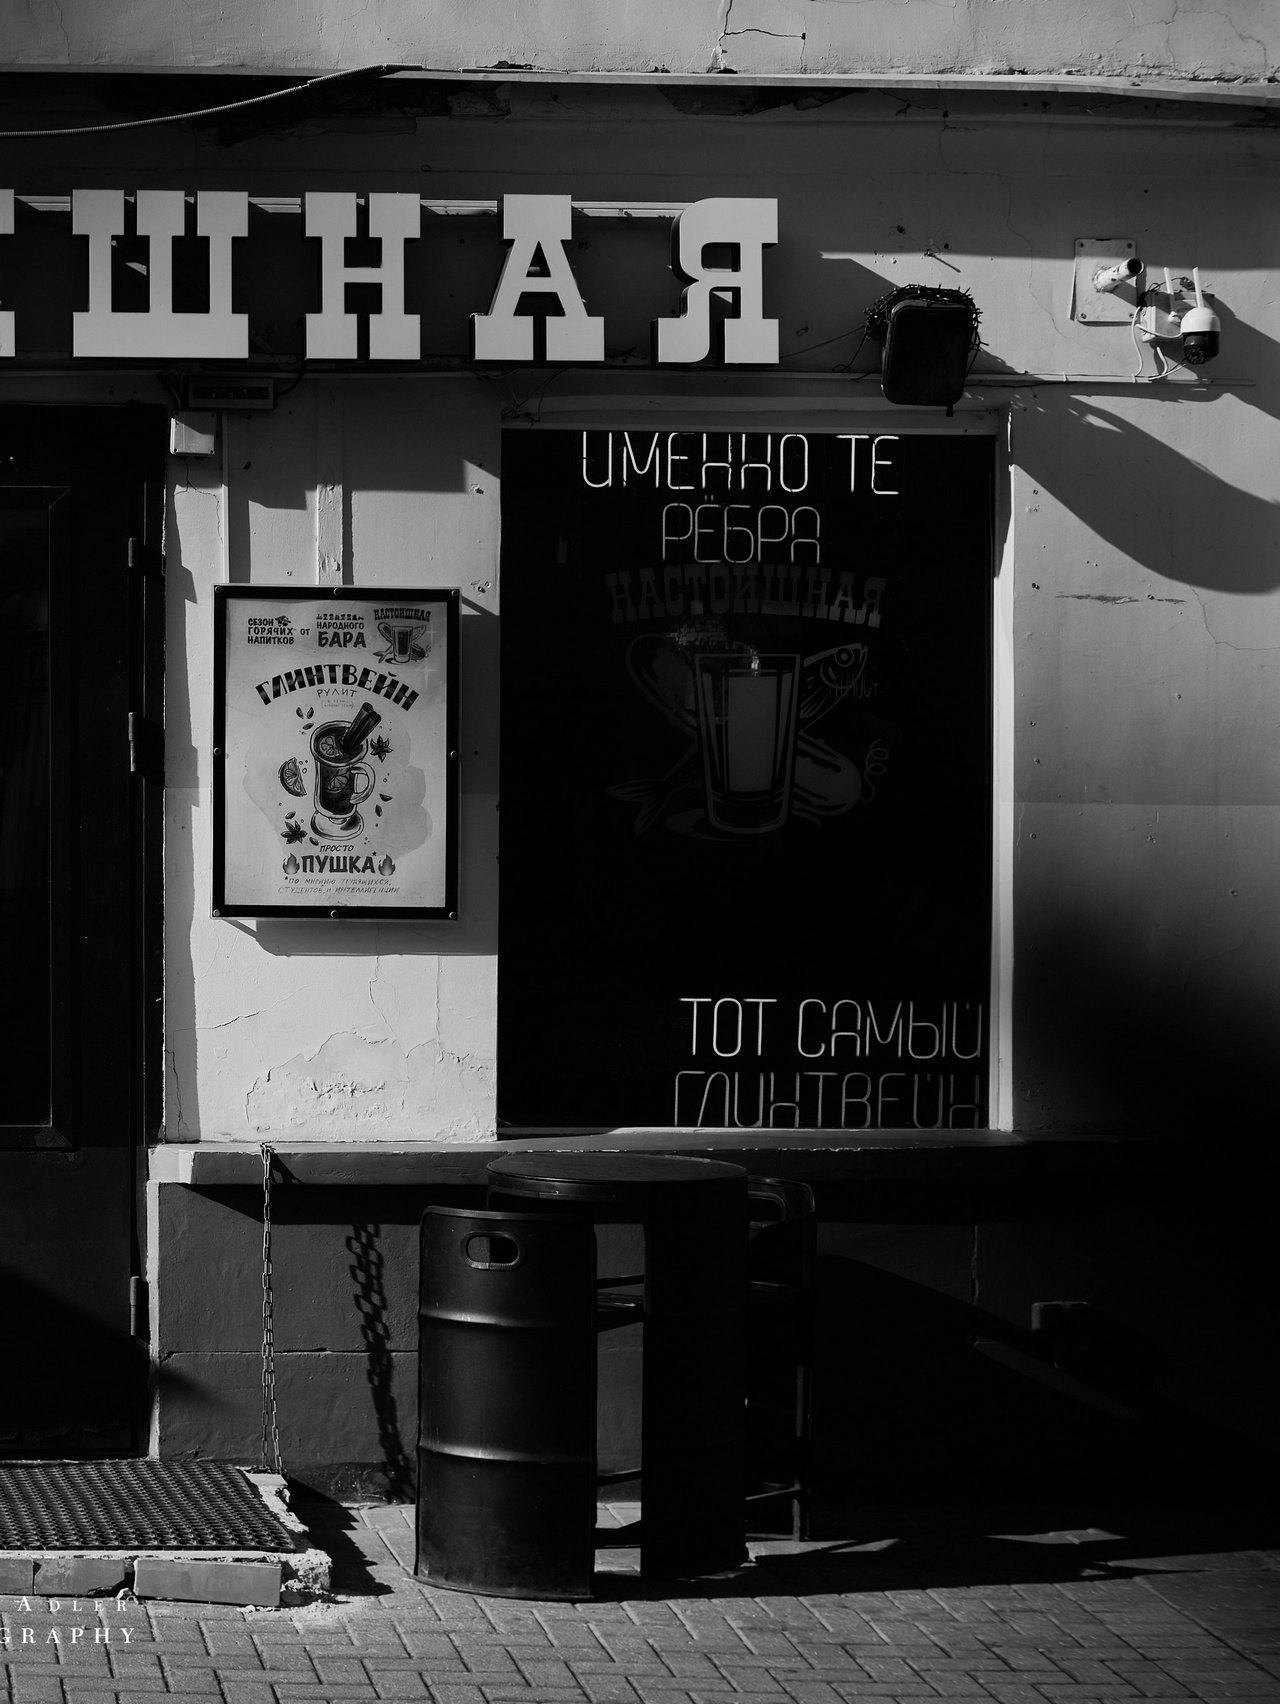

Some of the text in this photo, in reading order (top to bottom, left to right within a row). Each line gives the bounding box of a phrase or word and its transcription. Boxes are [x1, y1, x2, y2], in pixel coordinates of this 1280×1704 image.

[581, 429, 902, 497] ИМЕННО ТЕ
[661, 493, 823, 566] РЁБРА
[604, 562, 888, 629] НАСТОИШНАЯ
[247, 617, 275, 627] СЕЗОН
[373, 607, 432, 622] НАСТОИШНАЯ
[247, 626, 311, 636] ГОРЯЧИХ ОТ
[316, 620, 365, 630] НАРОДНОГО
[247, 635, 295, 645] НАПИТКОВ
[318, 631, 367, 649] БАРА
[255, 663, 420, 712] ГЛИНТВЕЙН
[316, 687, 358, 698] РУЛИТ
[319, 844, 354, 853] ПРОСТО
[677, 997, 984, 1061] ТОТ САМЫЙ
[673, 1069, 981, 1130] ГЛИНТВЕЙН
